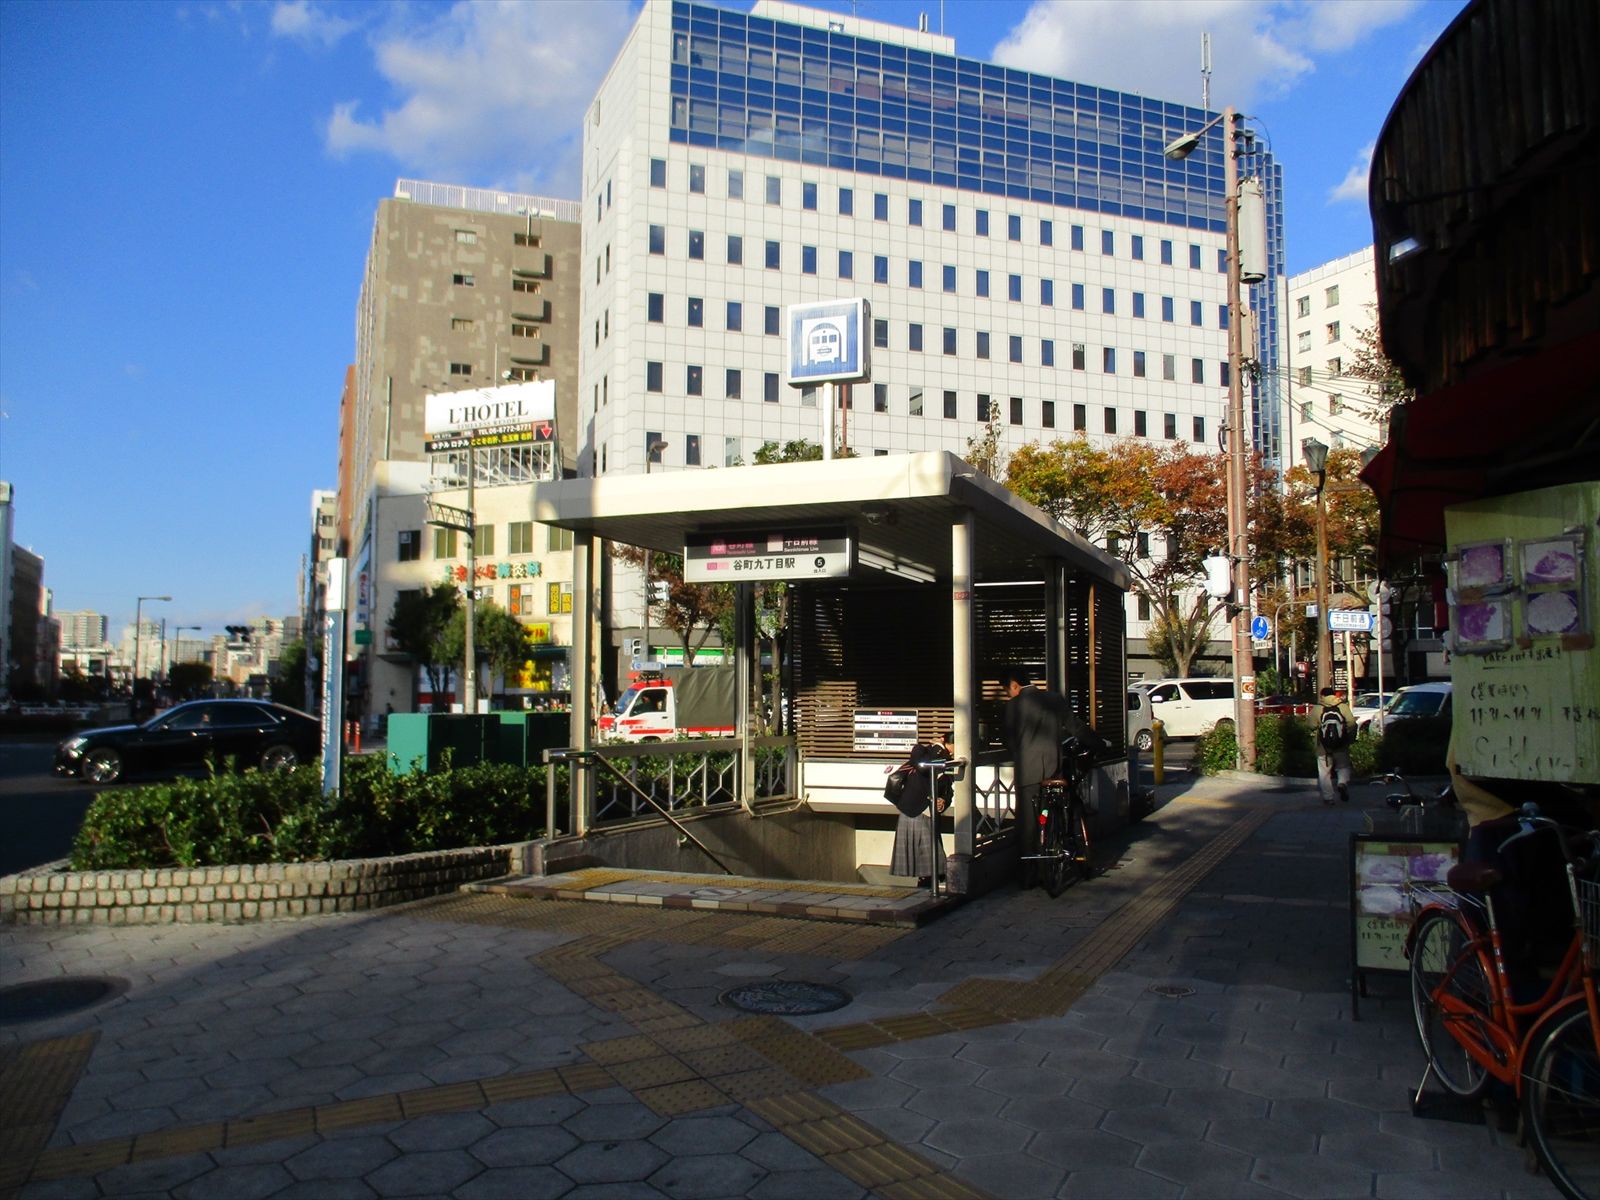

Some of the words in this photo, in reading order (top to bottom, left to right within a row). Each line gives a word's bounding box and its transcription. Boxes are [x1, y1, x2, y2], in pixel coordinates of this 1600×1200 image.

[449, 400, 529, 424] L'HOTEL
[733, 557, 796, 571] 谷町九丁目駅
